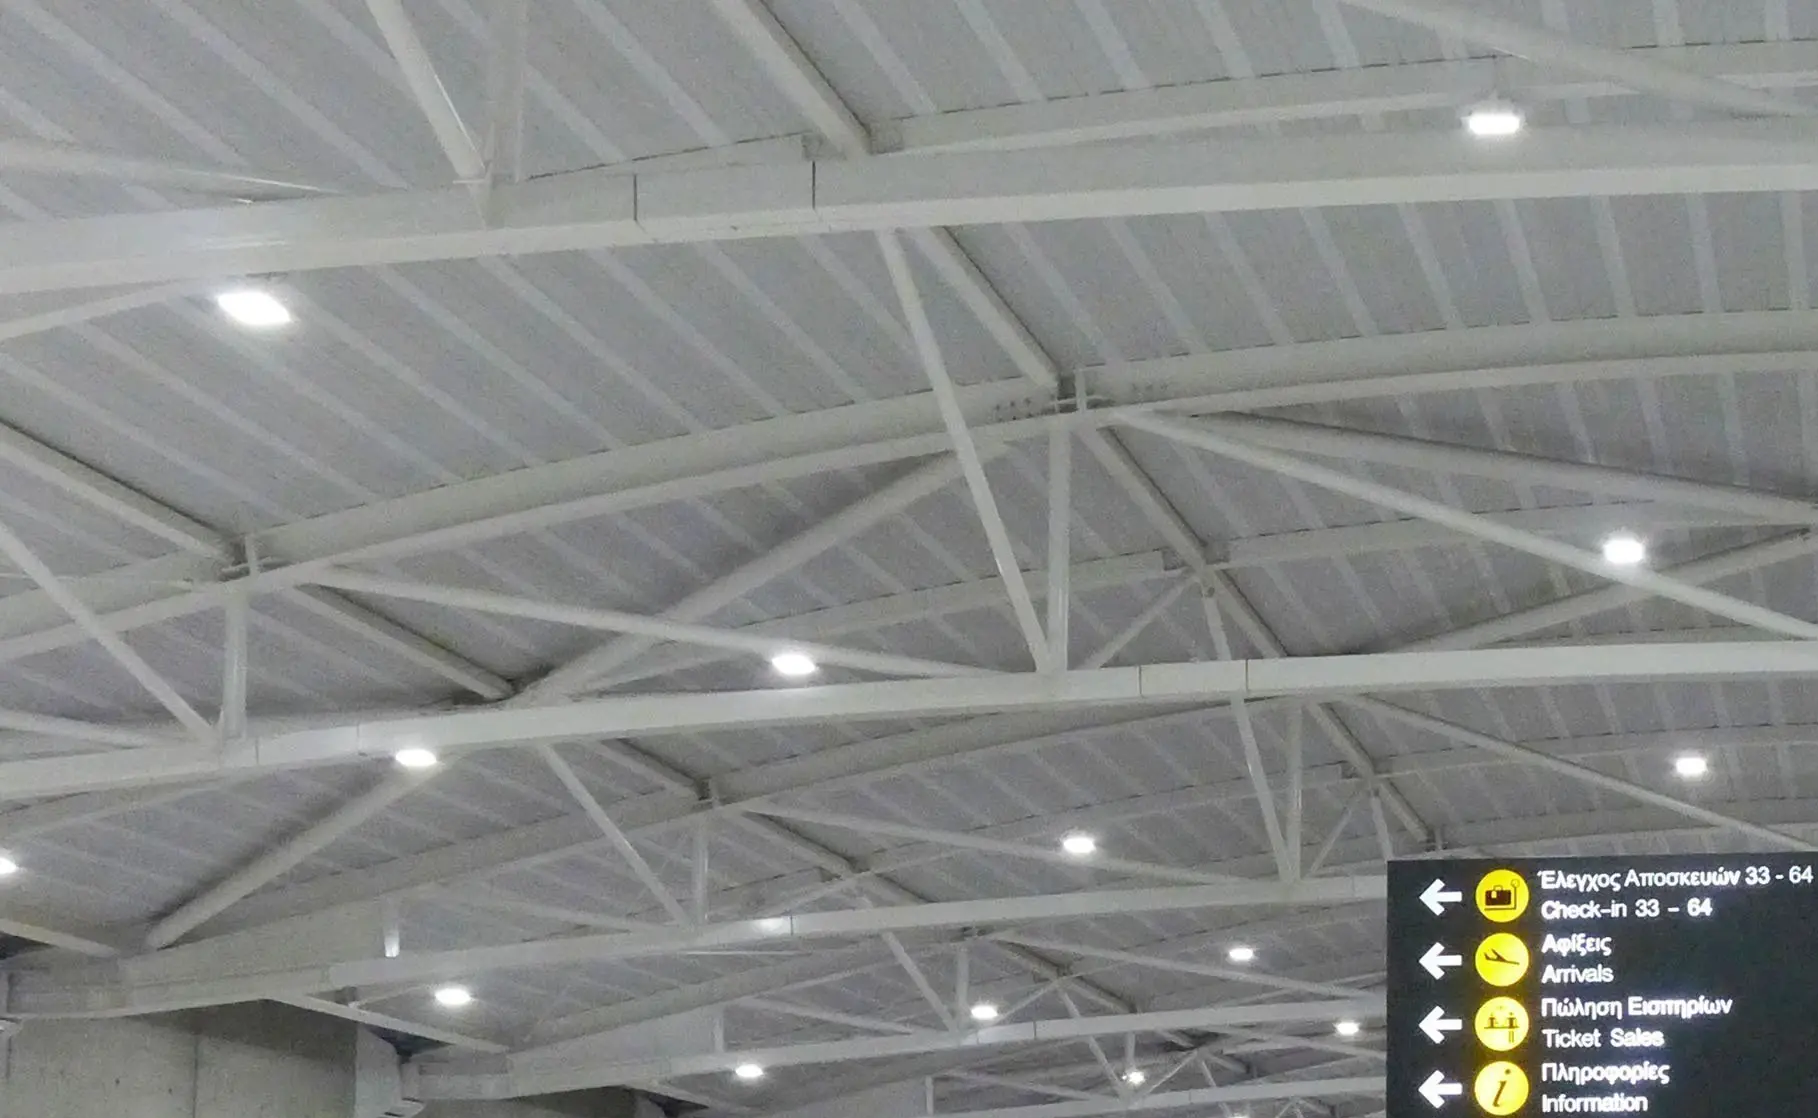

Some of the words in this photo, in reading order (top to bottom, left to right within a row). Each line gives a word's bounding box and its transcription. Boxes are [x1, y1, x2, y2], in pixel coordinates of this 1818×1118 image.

[1536, 869, 1622, 893] Έλεγχος
[1623, 866, 1742, 888] Αποσκευών
[1744, 865, 1771, 886] 33
[1787, 864, 1815, 885] 64
[1540, 899, 1628, 921] Check-in
[1634, 898, 1661, 918] 33
[1686, 896, 1714, 917] 64
[1540, 932, 1613, 958] Αφίξεις
[1540, 963, 1615, 985] Arrivals
[1540, 996, 1623, 1021] Πώληση
[1541, 1027, 1602, 1049] Ticket
[1609, 1026, 1666, 1048] Sales
[1541, 1060, 1671, 1086] Πληροφορίες
[1541, 1091, 1649, 1113] Information
